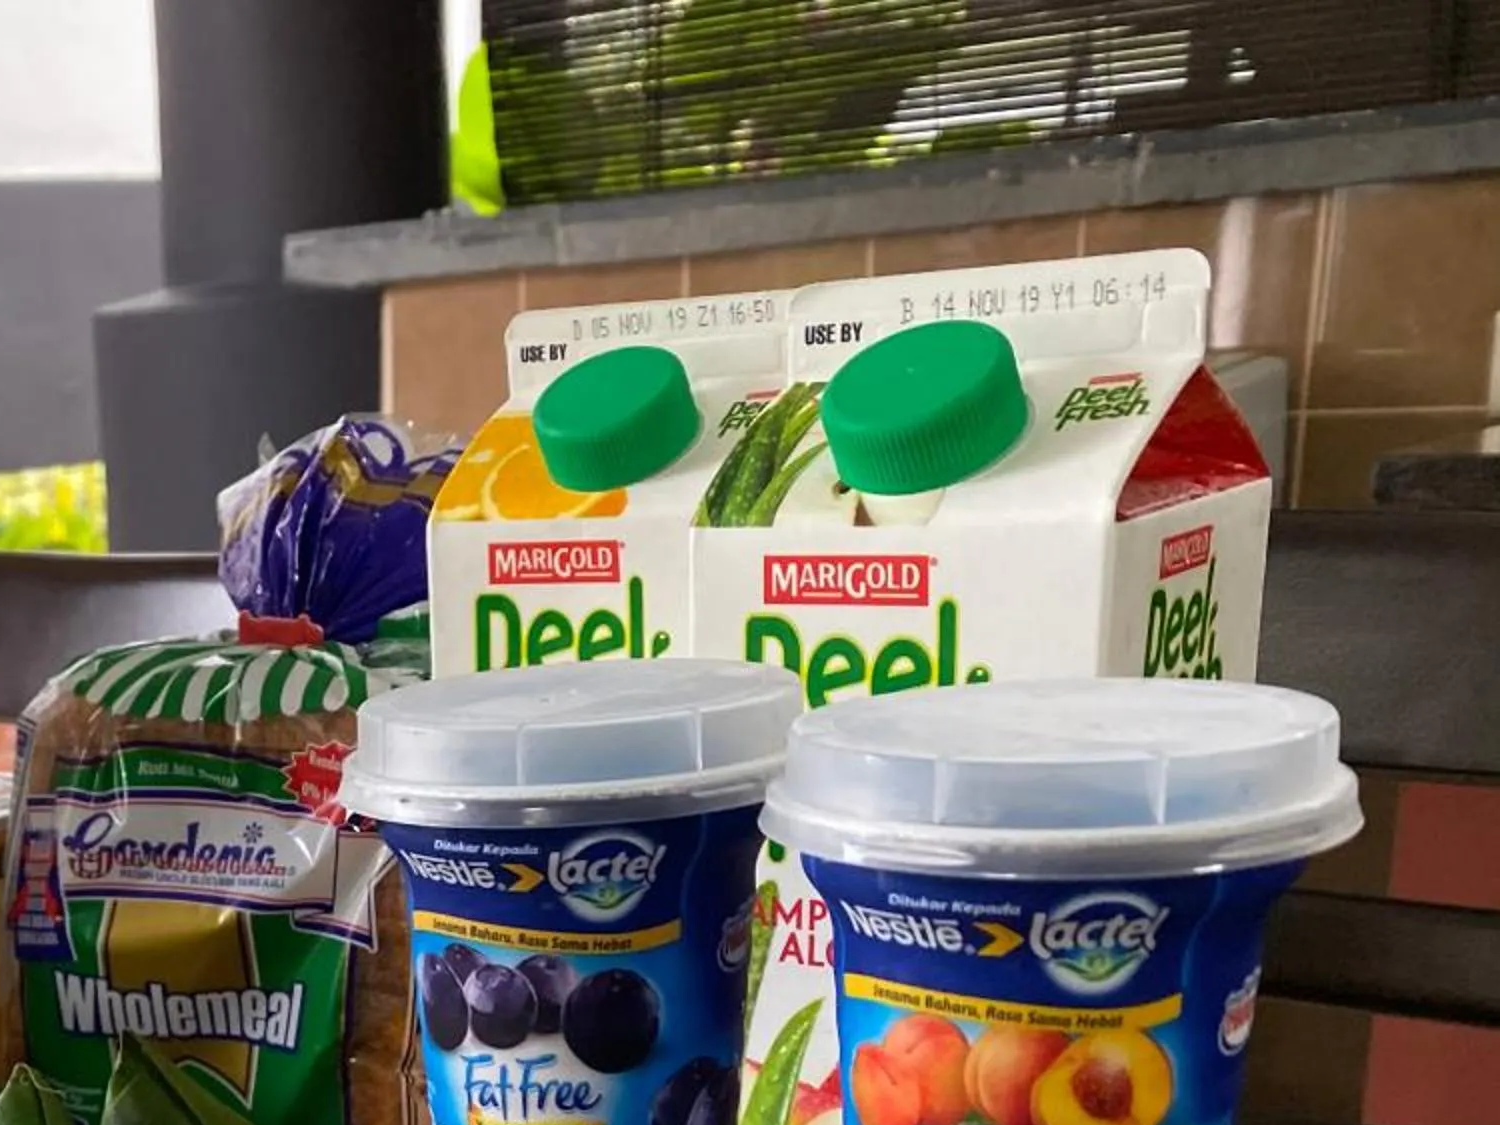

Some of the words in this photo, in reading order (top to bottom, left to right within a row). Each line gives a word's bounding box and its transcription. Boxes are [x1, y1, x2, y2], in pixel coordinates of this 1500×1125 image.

[900, 298, 913, 325] B
[932, 293, 955, 320] 14
[1020, 286, 1039, 313] 19
[1093, 273, 1165, 307] 06:14
[667, 307, 687, 330] 19
[805, 326, 836, 346] USE
[840, 322, 863, 342] BY
[521, 347, 545, 363] USE
[549, 344, 567, 361] BY
[495, 546, 613, 579] MARIGOLD
[771, 559, 921, 599] MARIGOLD
[62, 812, 277, 878] Gardenia
[951, 898, 1022, 916] Kepada
[54, 970, 303, 1049] Wholemeal
[986, 1006, 1024, 1024] Rasa
[1027, 1011, 1072, 1028] Sama
[515, 1053, 603, 1121] Free
